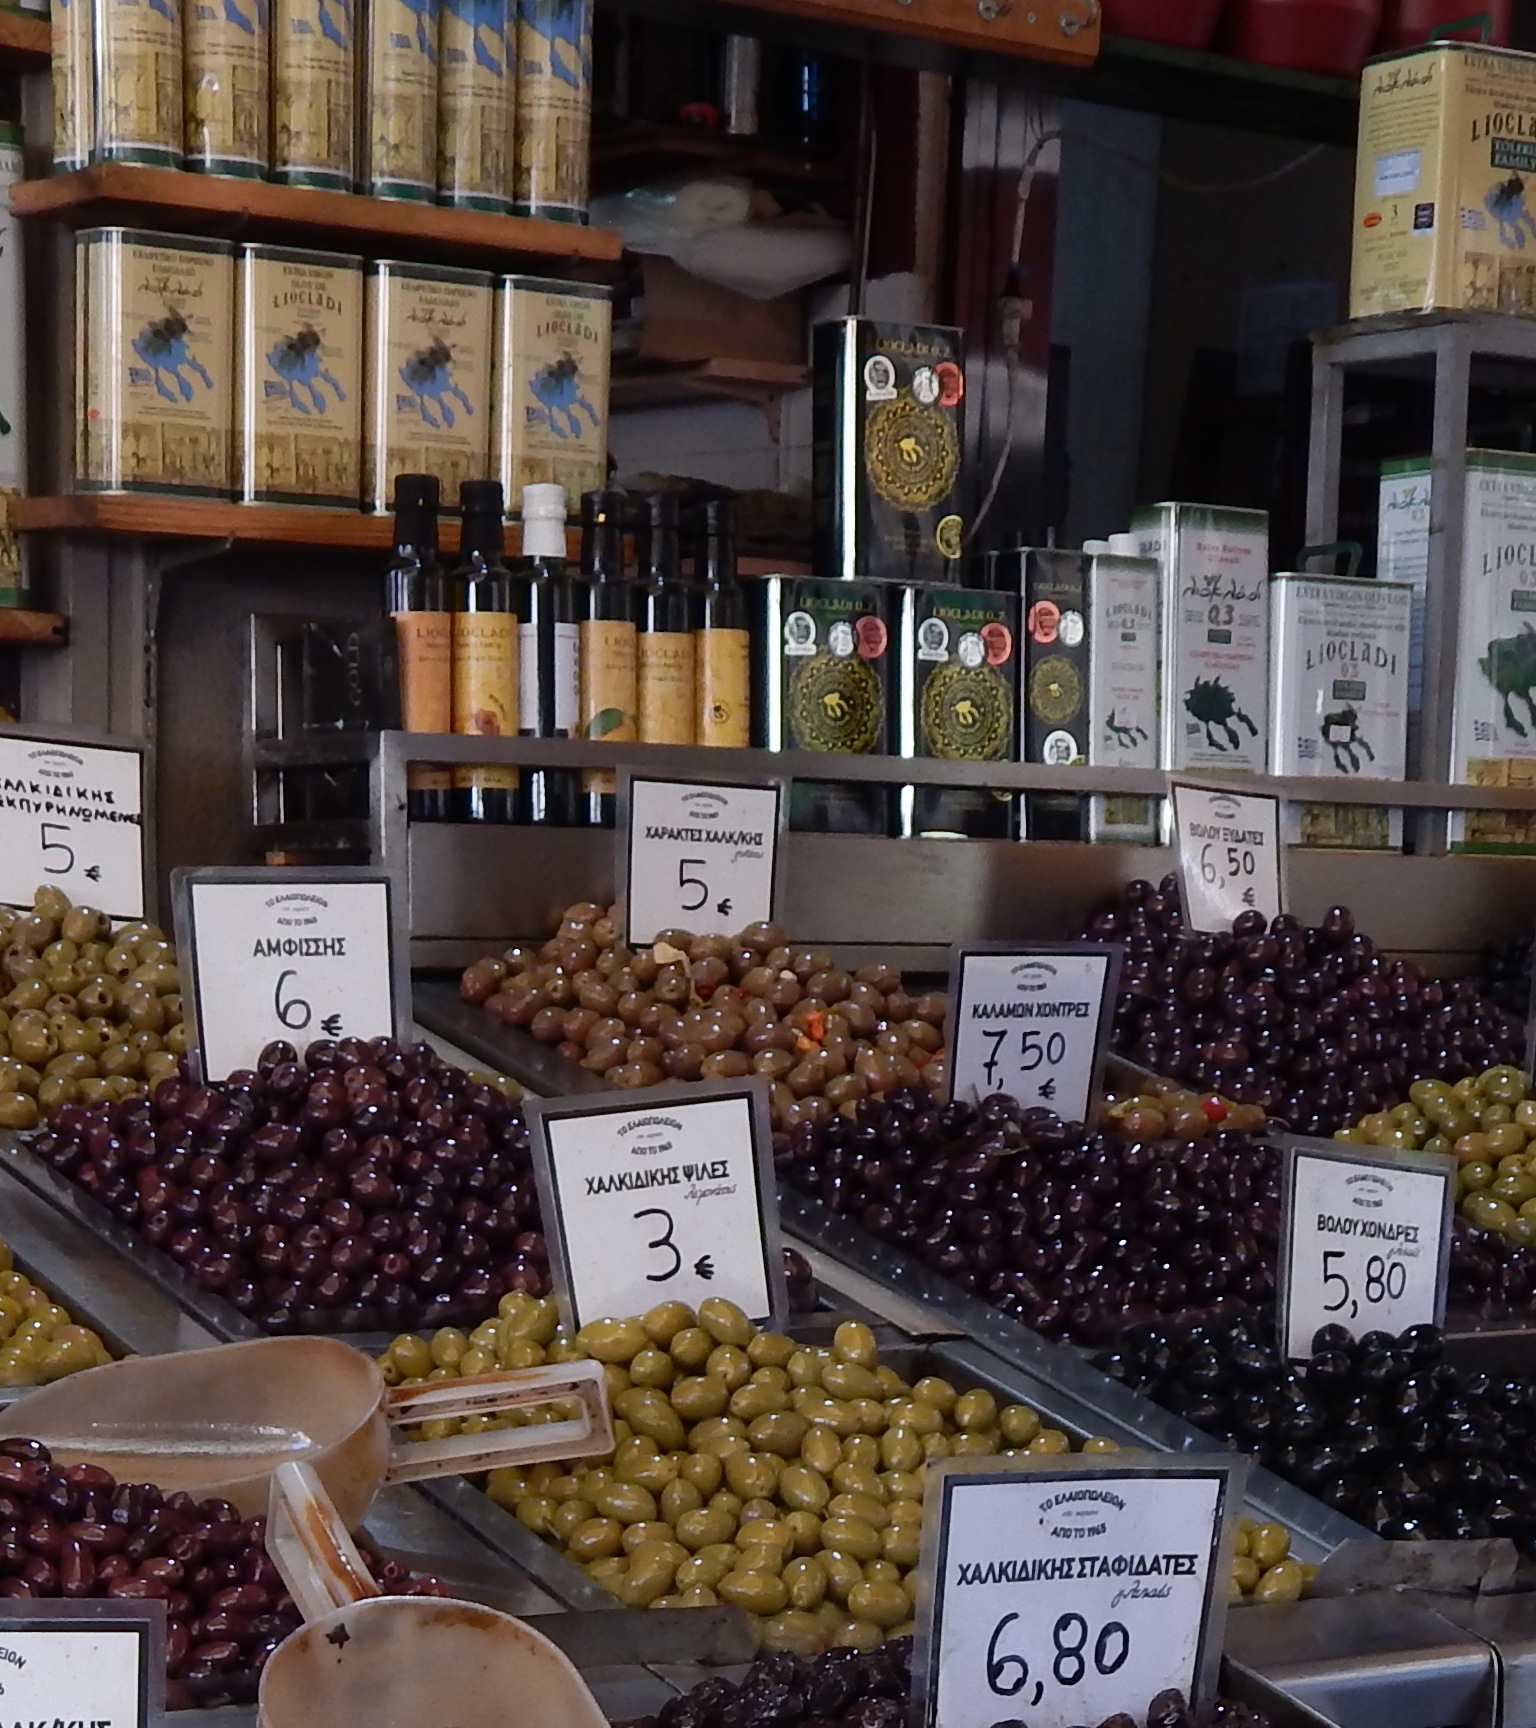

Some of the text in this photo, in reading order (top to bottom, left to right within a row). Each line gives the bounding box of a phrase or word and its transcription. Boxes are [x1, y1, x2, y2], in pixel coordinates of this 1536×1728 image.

[1306, 640, 1396, 675] LIOCLADI
[41, 823, 75, 874] 5
[645, 826, 764, 846] ΧΑΡΑΚΤΕΣ ΧΑΛΚ/ΚΗΣ
[679, 859, 709, 911] 5
[1200, 843, 1255, 890] 6,50
[253, 937, 346, 957] ΑΜΦΙΣΣΗΣ
[275, 969, 343, 1037] 6 €
[982, 1029, 1066, 1091] 7,50
[585, 1160, 730, 1196] ΧΑΛΚΙΔΙΚΗΣ ΨΙΛΕΣ
[634, 1208, 681, 1282] 3
[1323, 1250, 1406, 1319] 5,80
[957, 1554, 1198, 1586] ΧΑΛΚΙΔΙΚΗΣ ΣΤΑΦΙΔΑΤΕΣ
[986, 1612, 1130, 1706] 6,80
